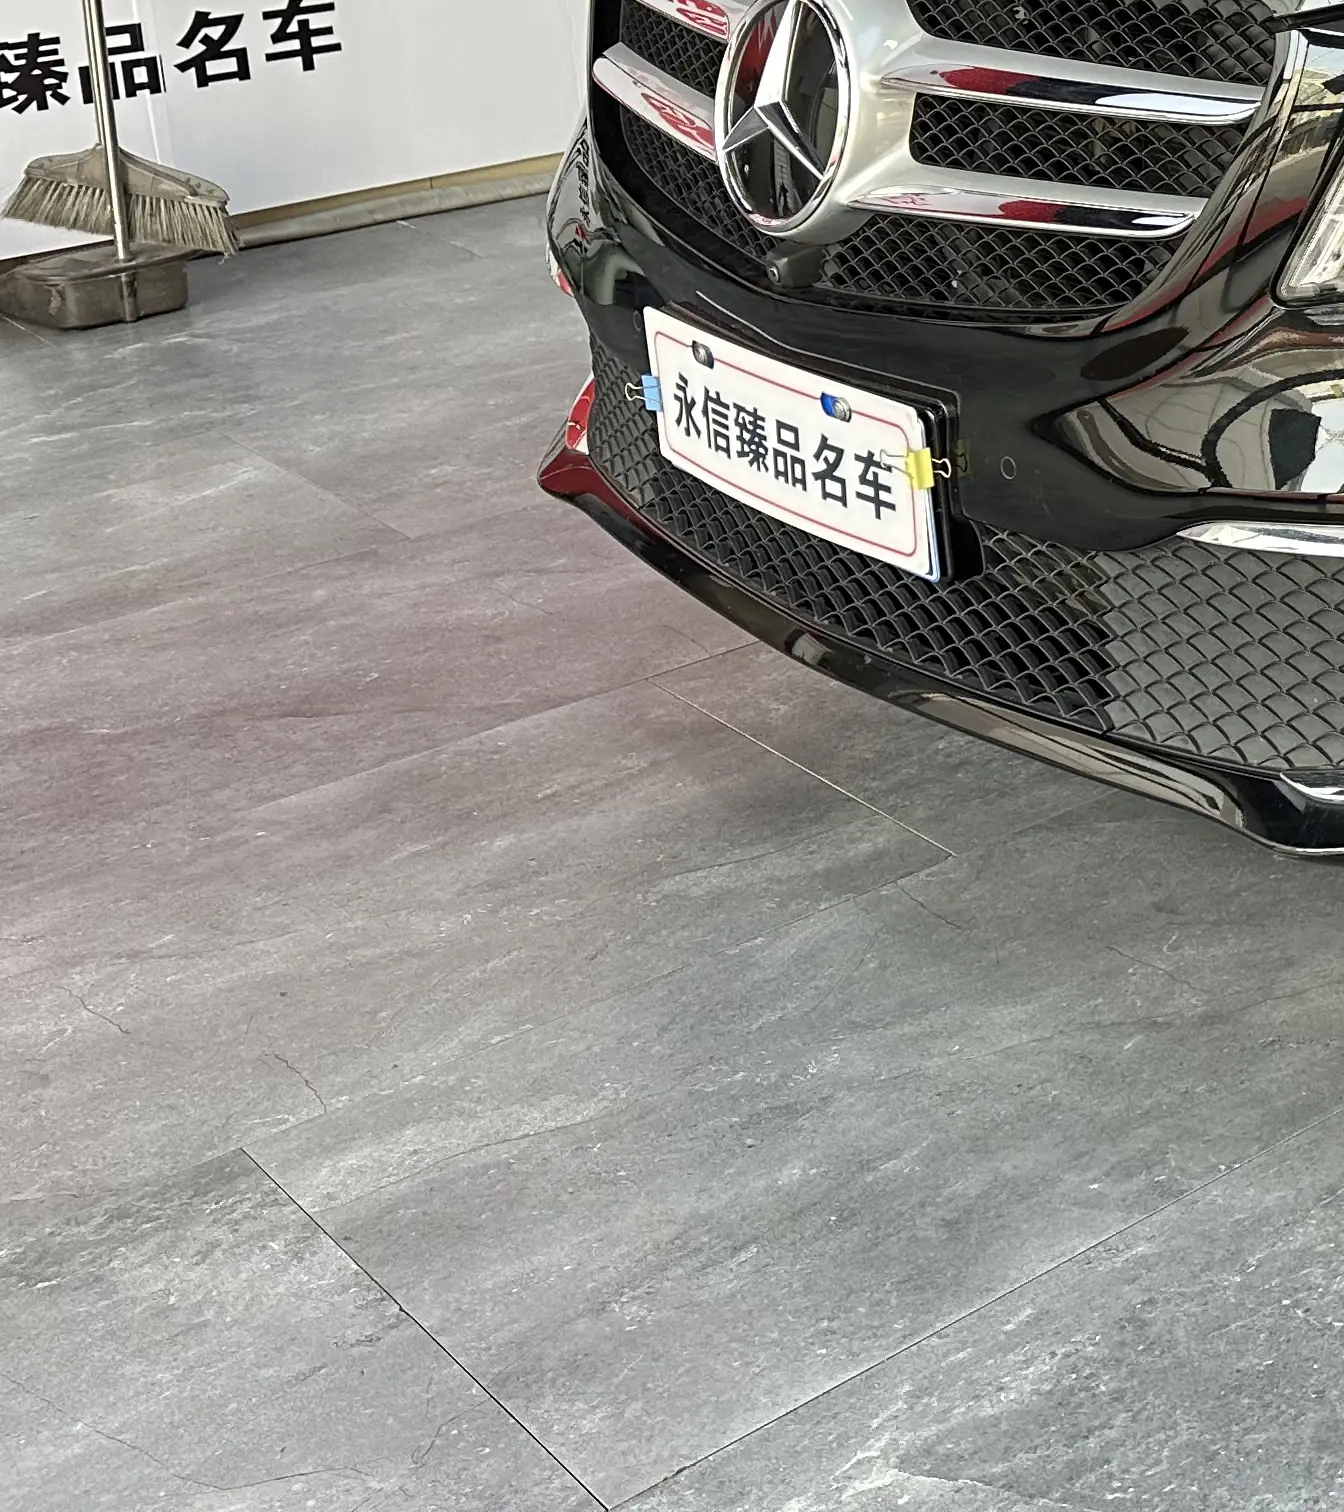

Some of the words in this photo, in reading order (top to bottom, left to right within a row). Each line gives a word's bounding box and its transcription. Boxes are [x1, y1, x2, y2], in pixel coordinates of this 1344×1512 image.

[673, 372, 897, 520] 永信臻品名车
